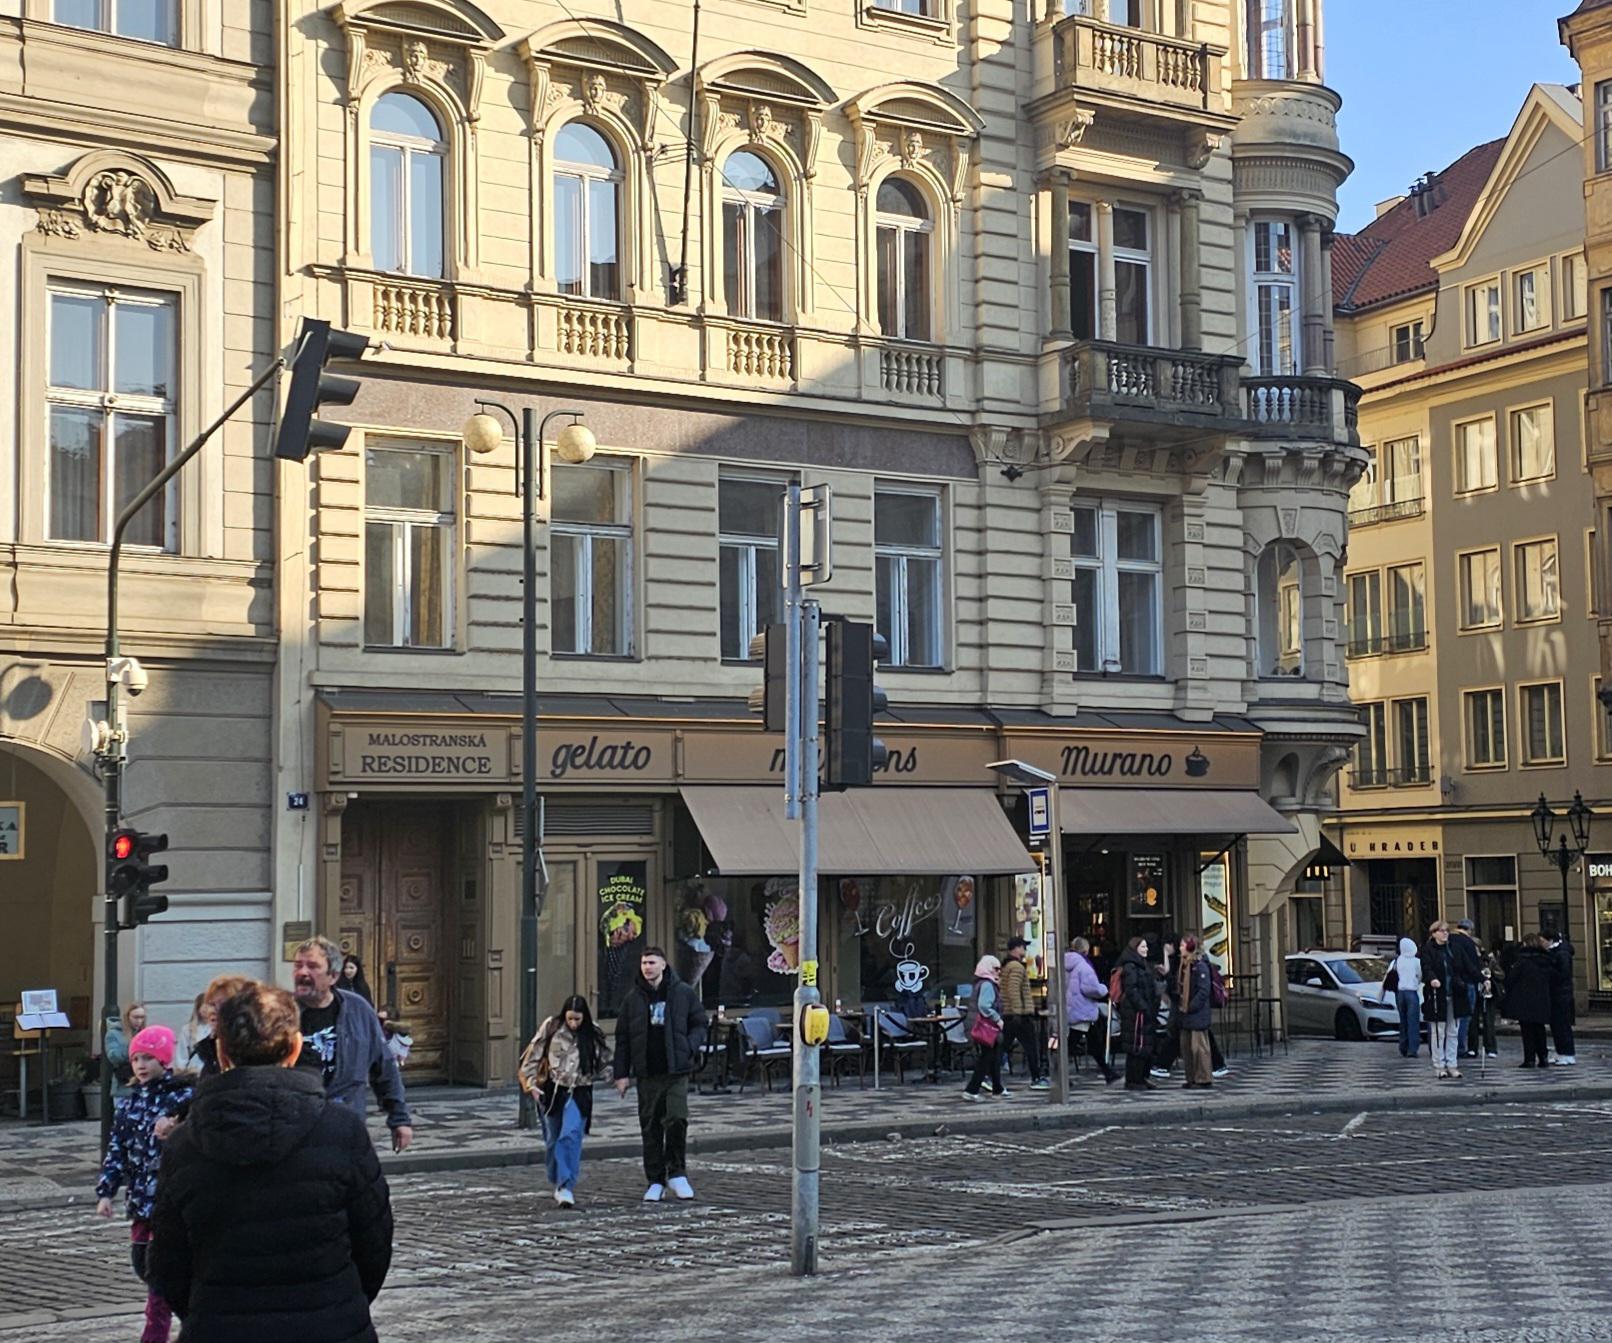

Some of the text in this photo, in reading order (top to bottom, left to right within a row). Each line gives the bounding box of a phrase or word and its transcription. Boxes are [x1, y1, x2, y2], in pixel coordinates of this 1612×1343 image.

[368, 733, 487, 748] MALOSTRANSKÁ
[550, 735, 652, 777] gelato
[1061, 745, 1172, 776] Murano
[360, 756, 492, 774] RESIDENCE
[1350, 841, 1439, 853] U HRADEB
[610, 876, 634, 884] DUBAI
[599, 885, 645, 896] CHOCOLATE
[601, 894, 643, 903] ICE CREAM
[876, 884, 942, 940] Coffee
